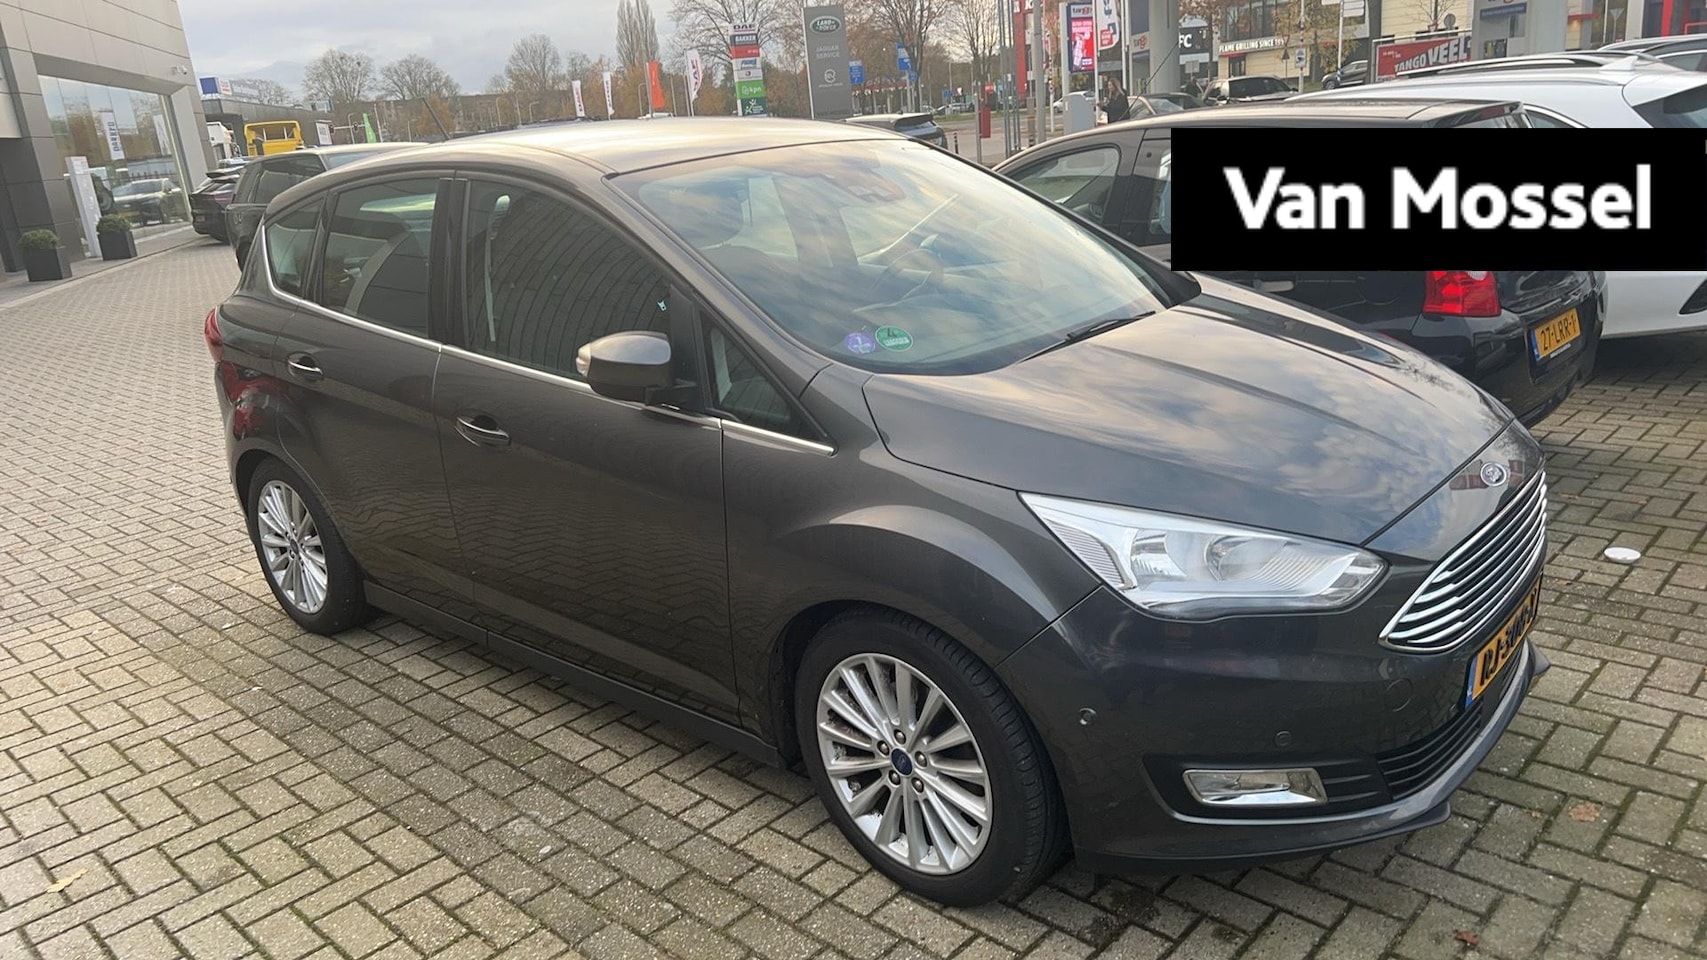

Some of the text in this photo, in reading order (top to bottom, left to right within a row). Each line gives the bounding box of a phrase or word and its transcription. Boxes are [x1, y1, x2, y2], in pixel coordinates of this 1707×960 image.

[1219, 44, 1235, 52] FLAME
[1235, 40, 1259, 51] GRILLING
[1260, 39, 1274, 48] SINCE
[1394, 35, 1467, 72] TANGO VEEL
